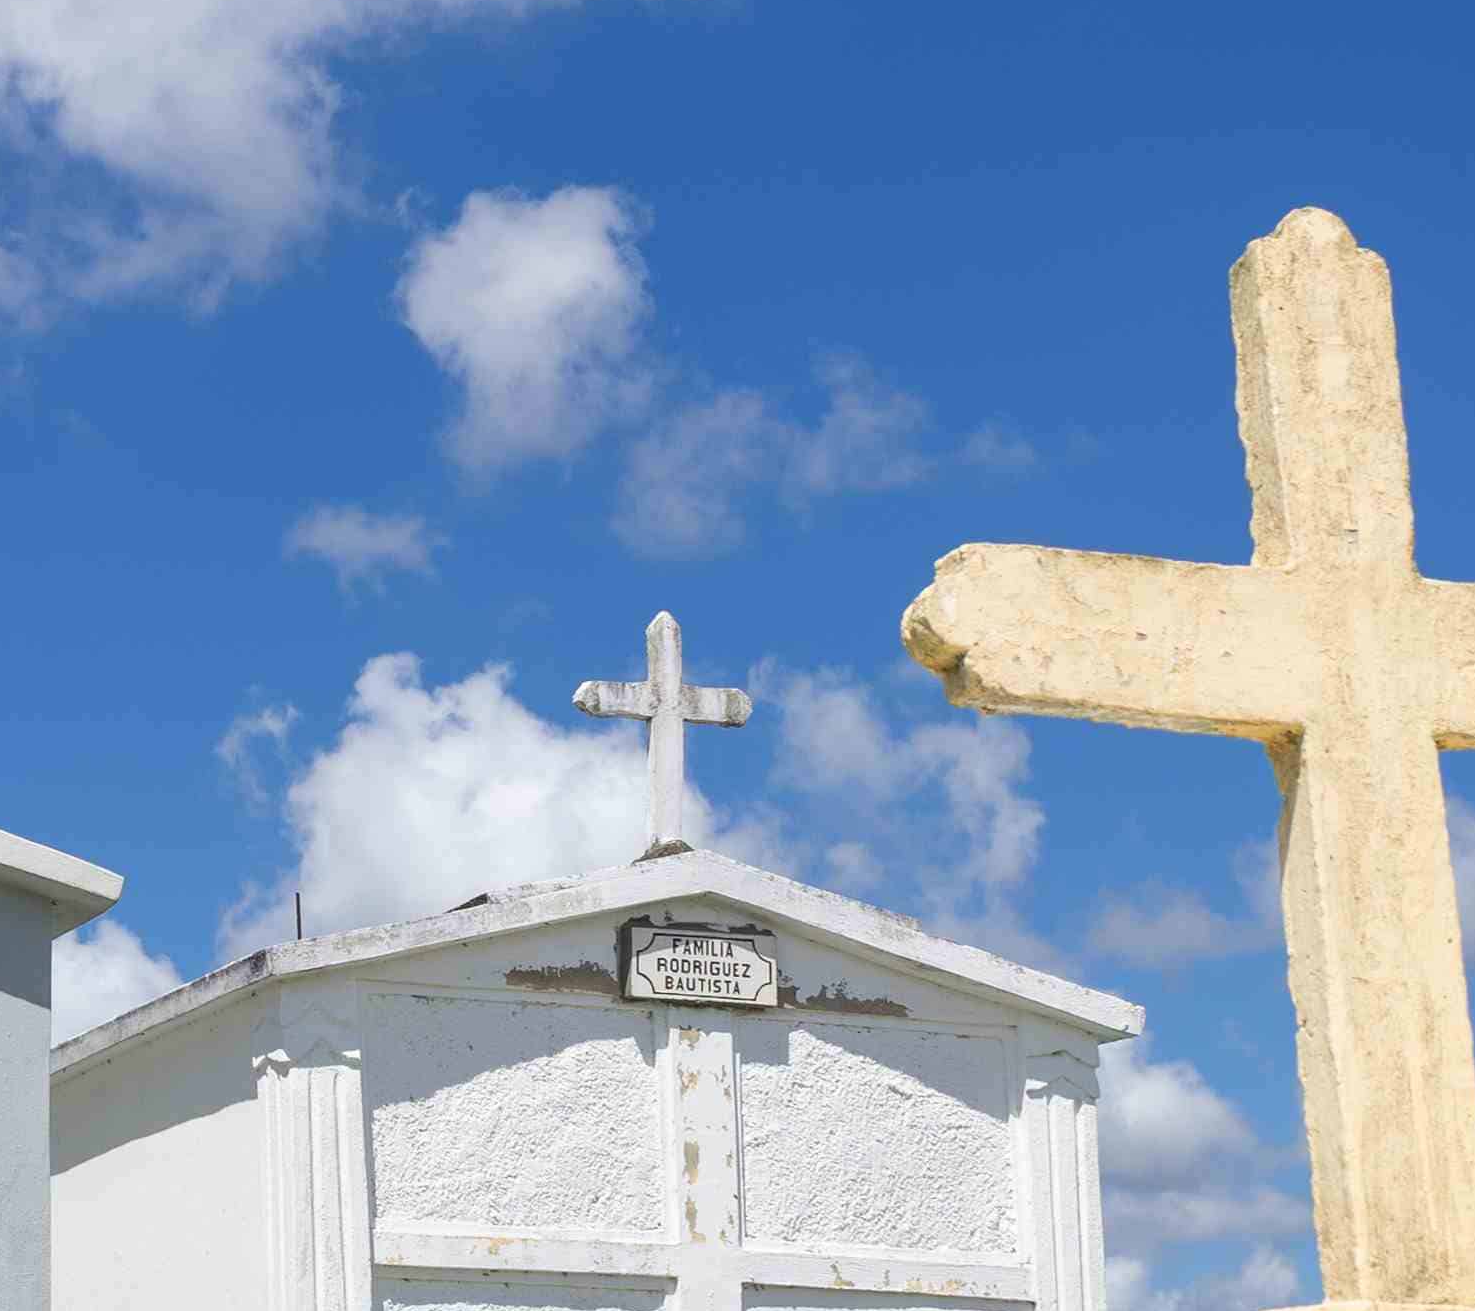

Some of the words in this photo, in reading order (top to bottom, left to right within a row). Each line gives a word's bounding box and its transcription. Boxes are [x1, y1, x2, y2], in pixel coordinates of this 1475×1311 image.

[672, 939, 733, 958] FAMILIA
[657, 958, 751, 978] RODRIGUEZ
[665, 976, 740, 995] BAUTISTA
